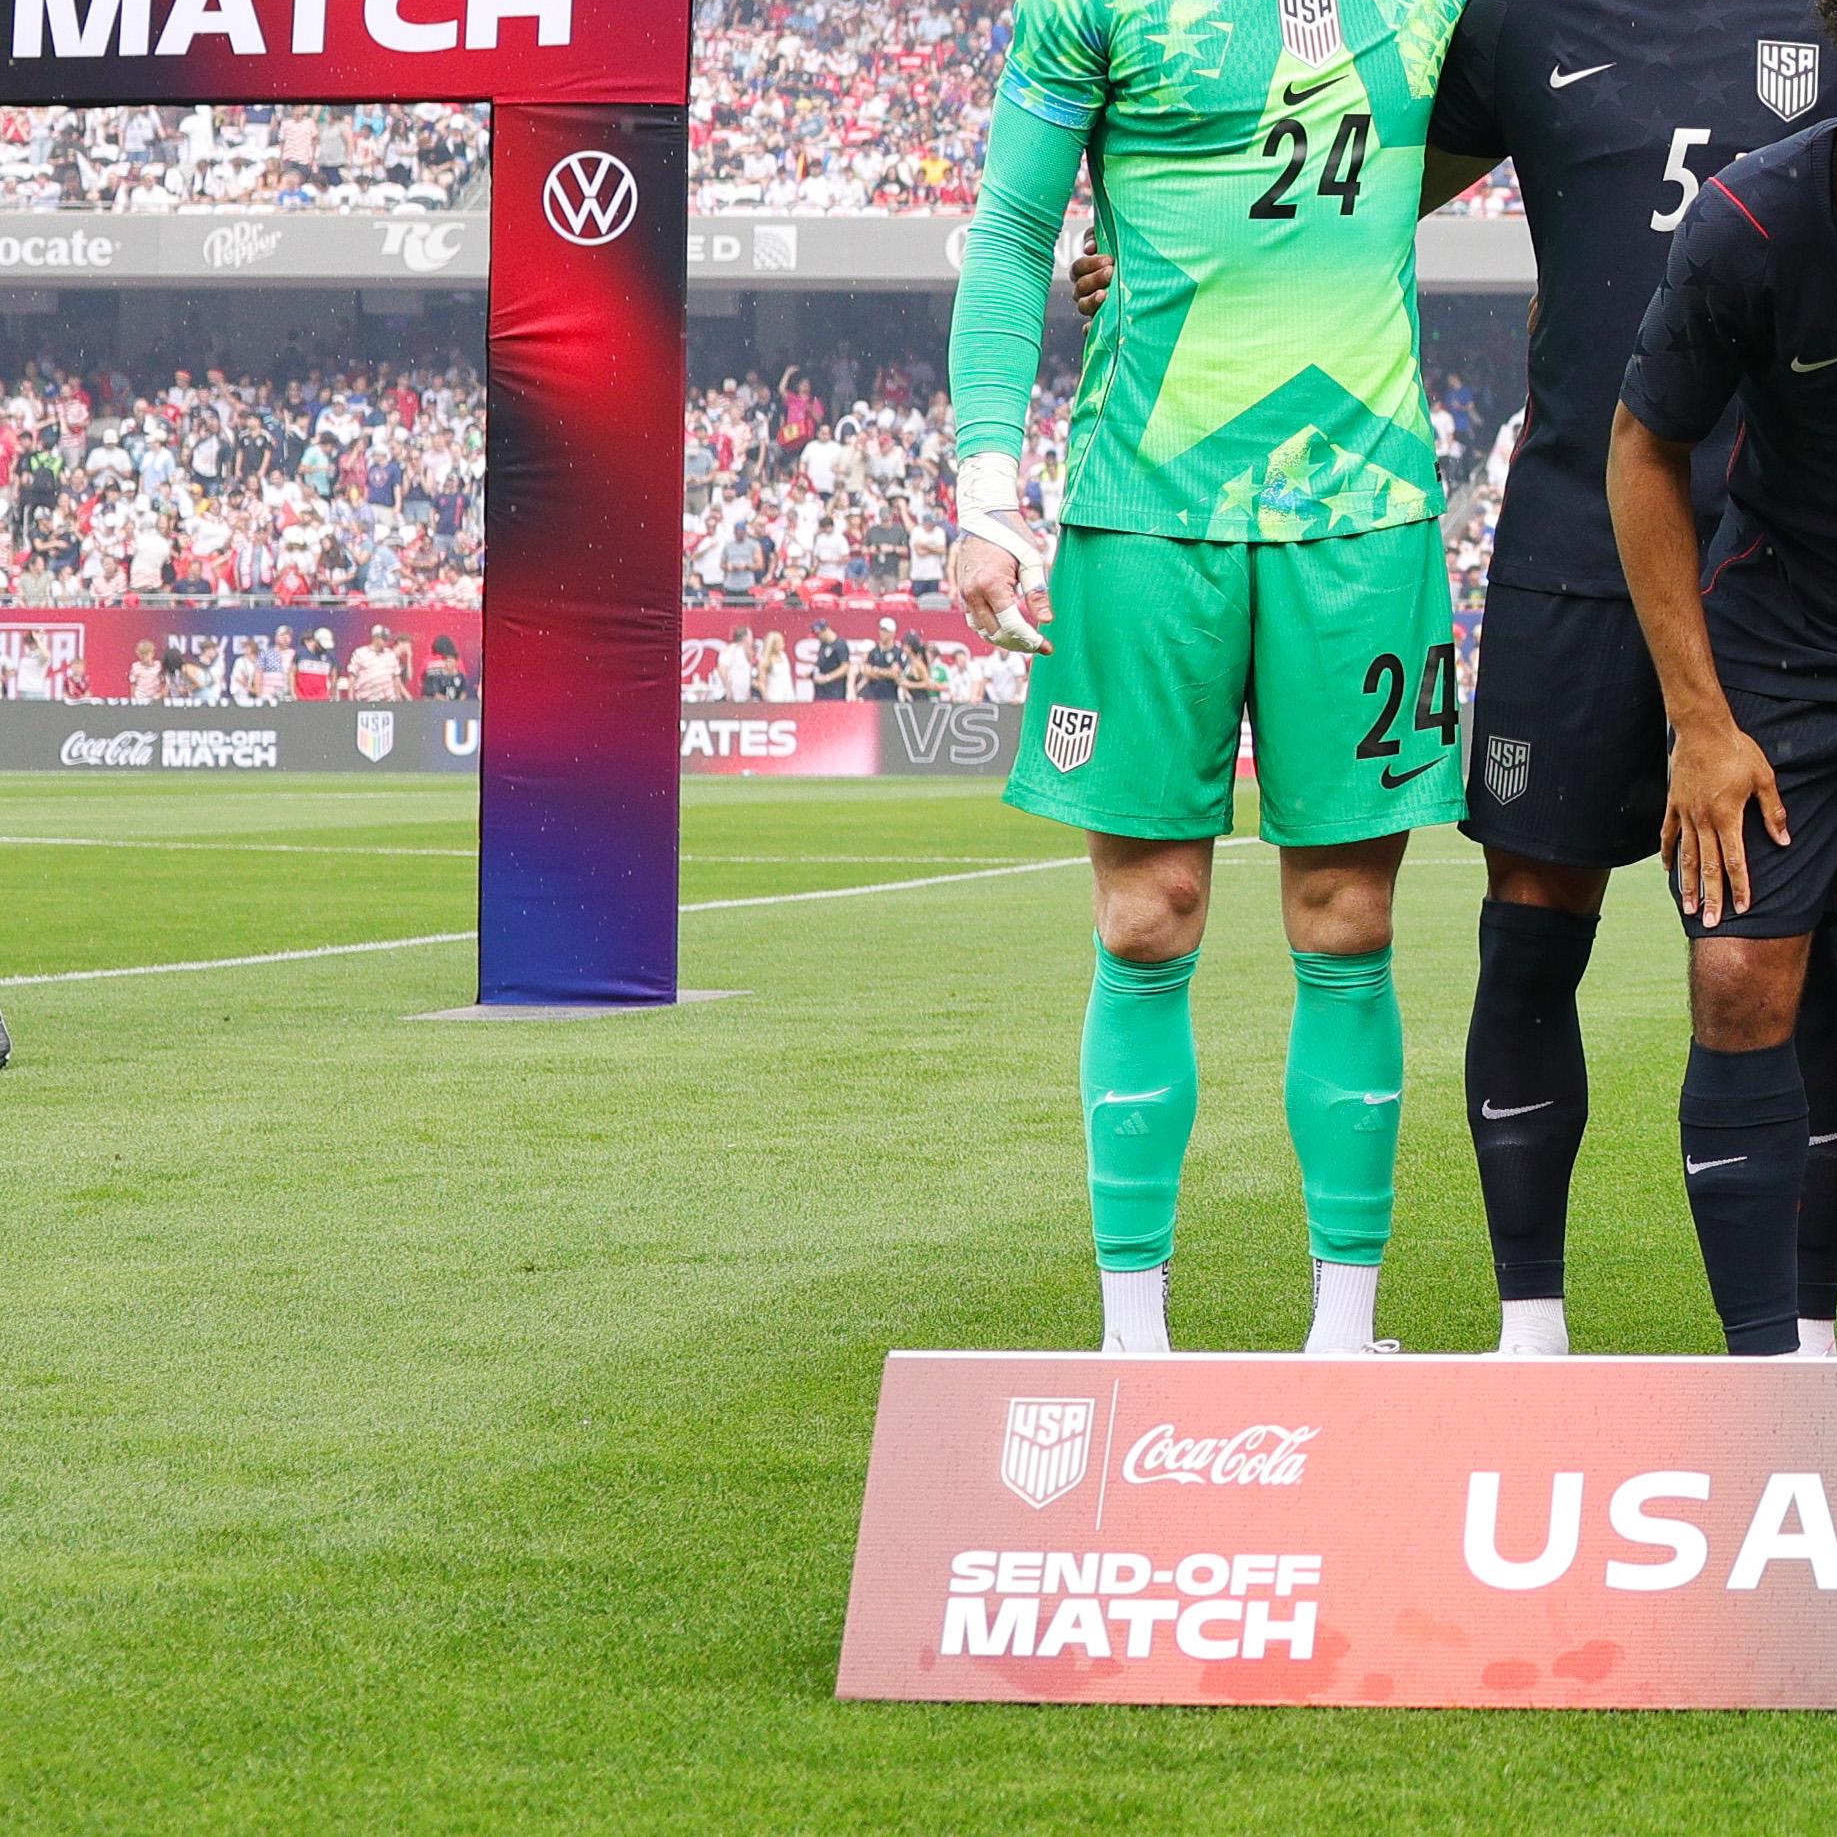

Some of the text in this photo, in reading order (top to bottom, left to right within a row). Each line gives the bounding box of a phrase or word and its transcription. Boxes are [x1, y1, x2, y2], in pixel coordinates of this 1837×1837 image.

[1764, 45, 1813, 73] USA
[1249, 113, 1371, 220] 24
[1650, 128, 1711, 232] 5
[1051, 708, 1094, 735] USA
[1355, 643, 1459, 760] 24
[60, 730, 159, 766] Coca-Cola
[162, 730, 277, 747] SEND-OFF
[162, 745, 277, 767] MATCH
[894, 703, 1000, 764] VS
[1488, 742, 1528, 768] USA
[1013, 1403, 1088, 1447] USA
[1122, 1423, 1322, 1486] Coca-Cola
[949, 1550, 1322, 1596] SEND-OFF
[940, 1597, 1318, 1660] MATCH
